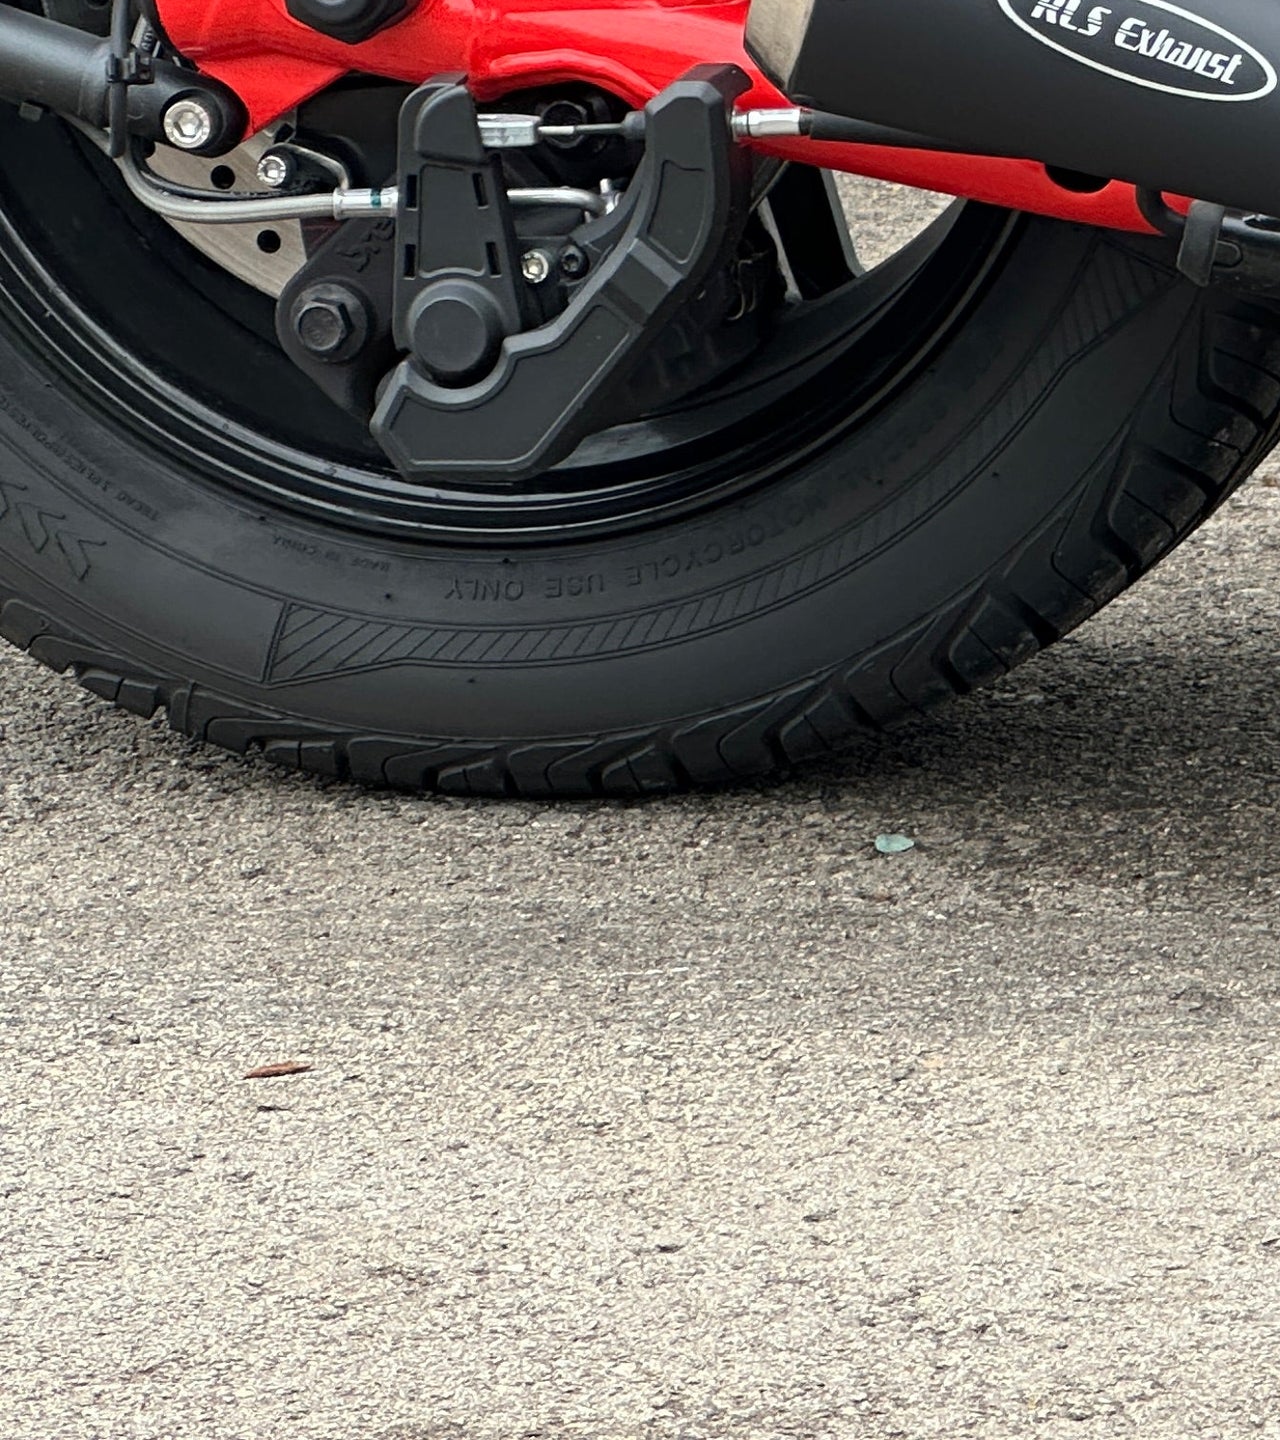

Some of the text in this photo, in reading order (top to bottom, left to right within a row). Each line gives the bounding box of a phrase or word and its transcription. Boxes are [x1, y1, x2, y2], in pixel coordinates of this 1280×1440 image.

[1114, 16, 1244, 86] Exhaust
[622, 491, 829, 588] MOTORCYCLE
[445, 572, 526, 603] ONLY
[542, 568, 606, 600] USE
